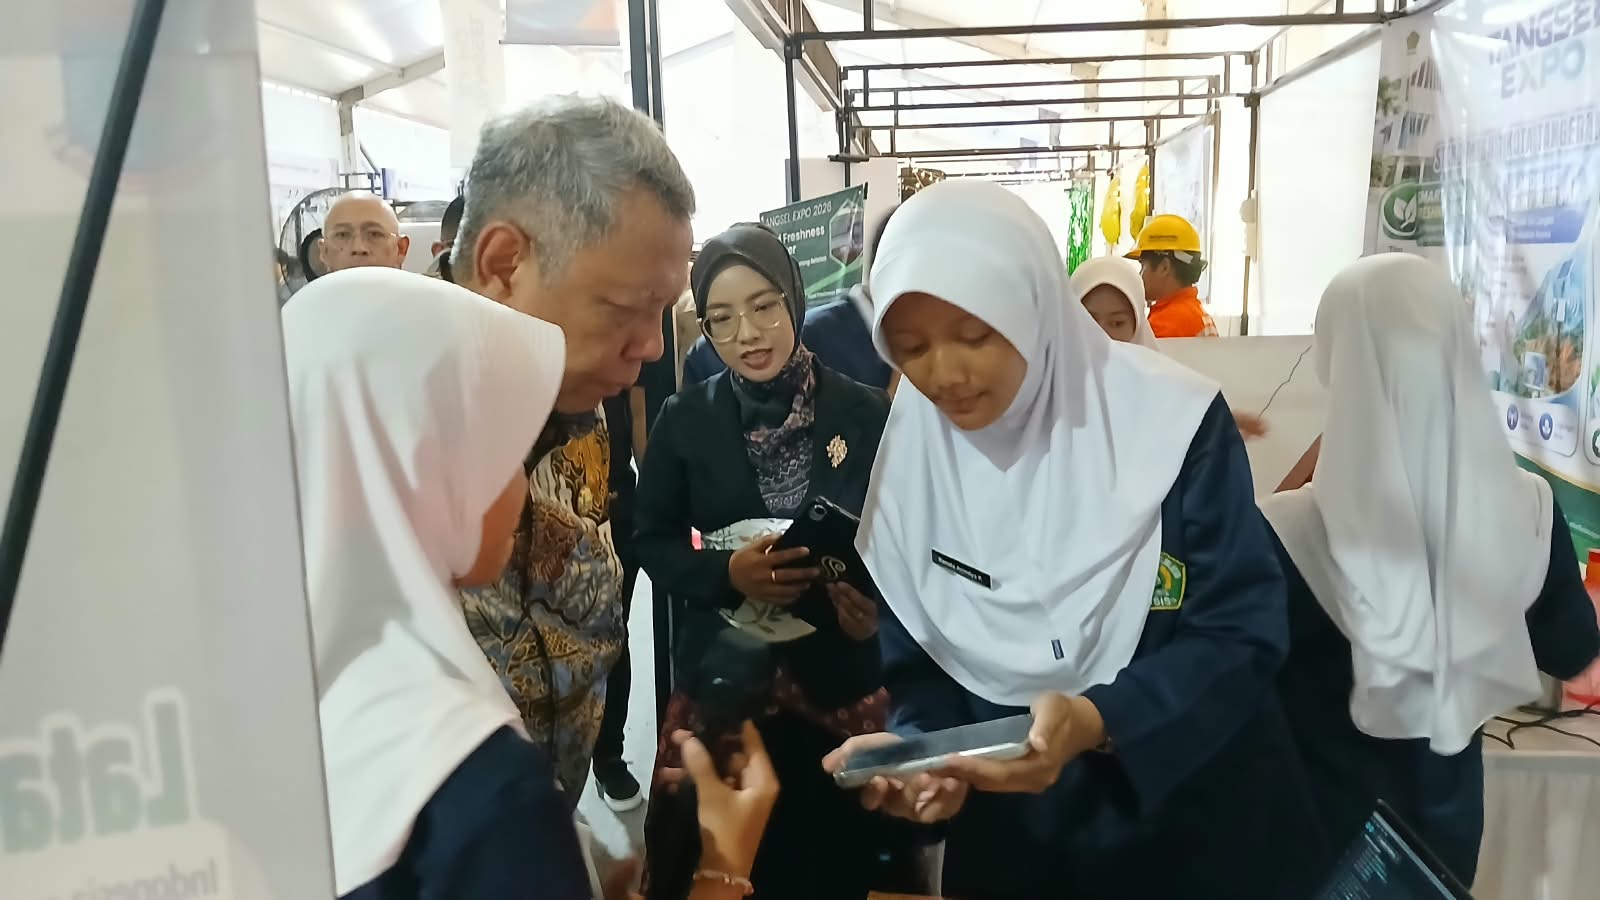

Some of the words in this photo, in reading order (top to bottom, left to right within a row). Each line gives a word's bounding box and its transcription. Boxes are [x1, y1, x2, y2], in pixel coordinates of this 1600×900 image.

[1501, 39, 1585, 99] EXPO
[764, 212, 790, 227] ANGSEL
[792, 206, 812, 222] EXPO
[782, 225, 825, 244] Freshness
